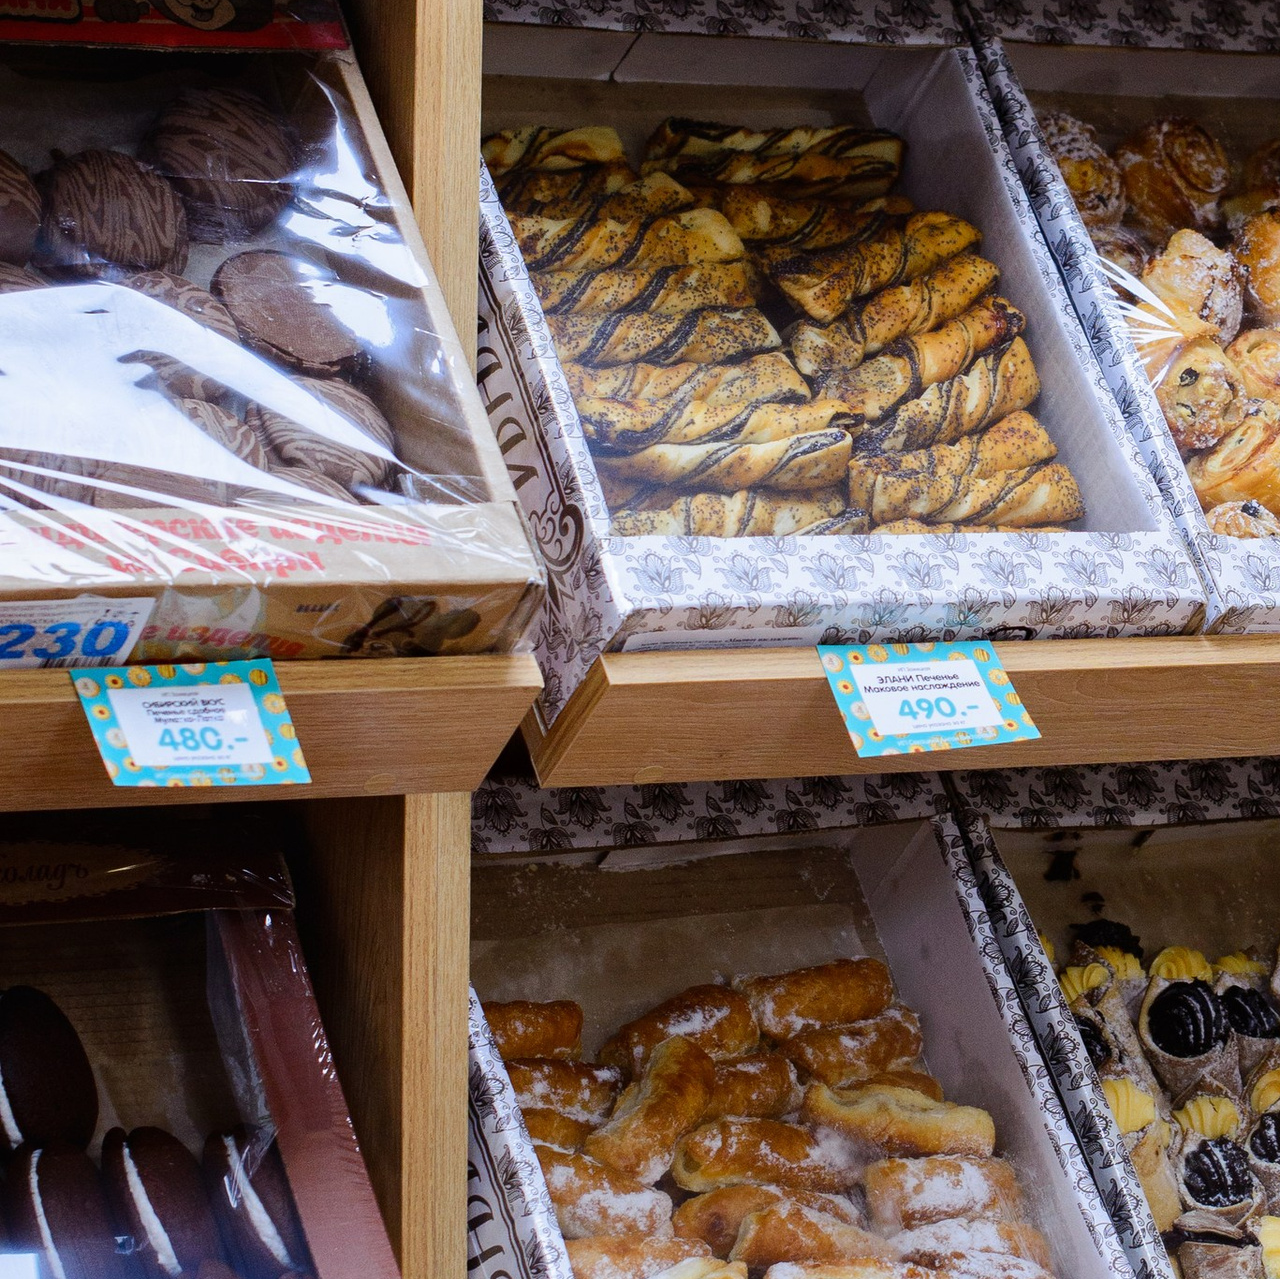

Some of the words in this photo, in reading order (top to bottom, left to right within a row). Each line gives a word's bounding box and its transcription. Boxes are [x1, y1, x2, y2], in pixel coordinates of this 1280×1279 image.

[876, 675, 914, 684] ЭЛАНИ
[917, 673, 959, 683] Печенье
[864, 684, 909, 694] Маковое
[912, 681, 980, 692] наслаждение
